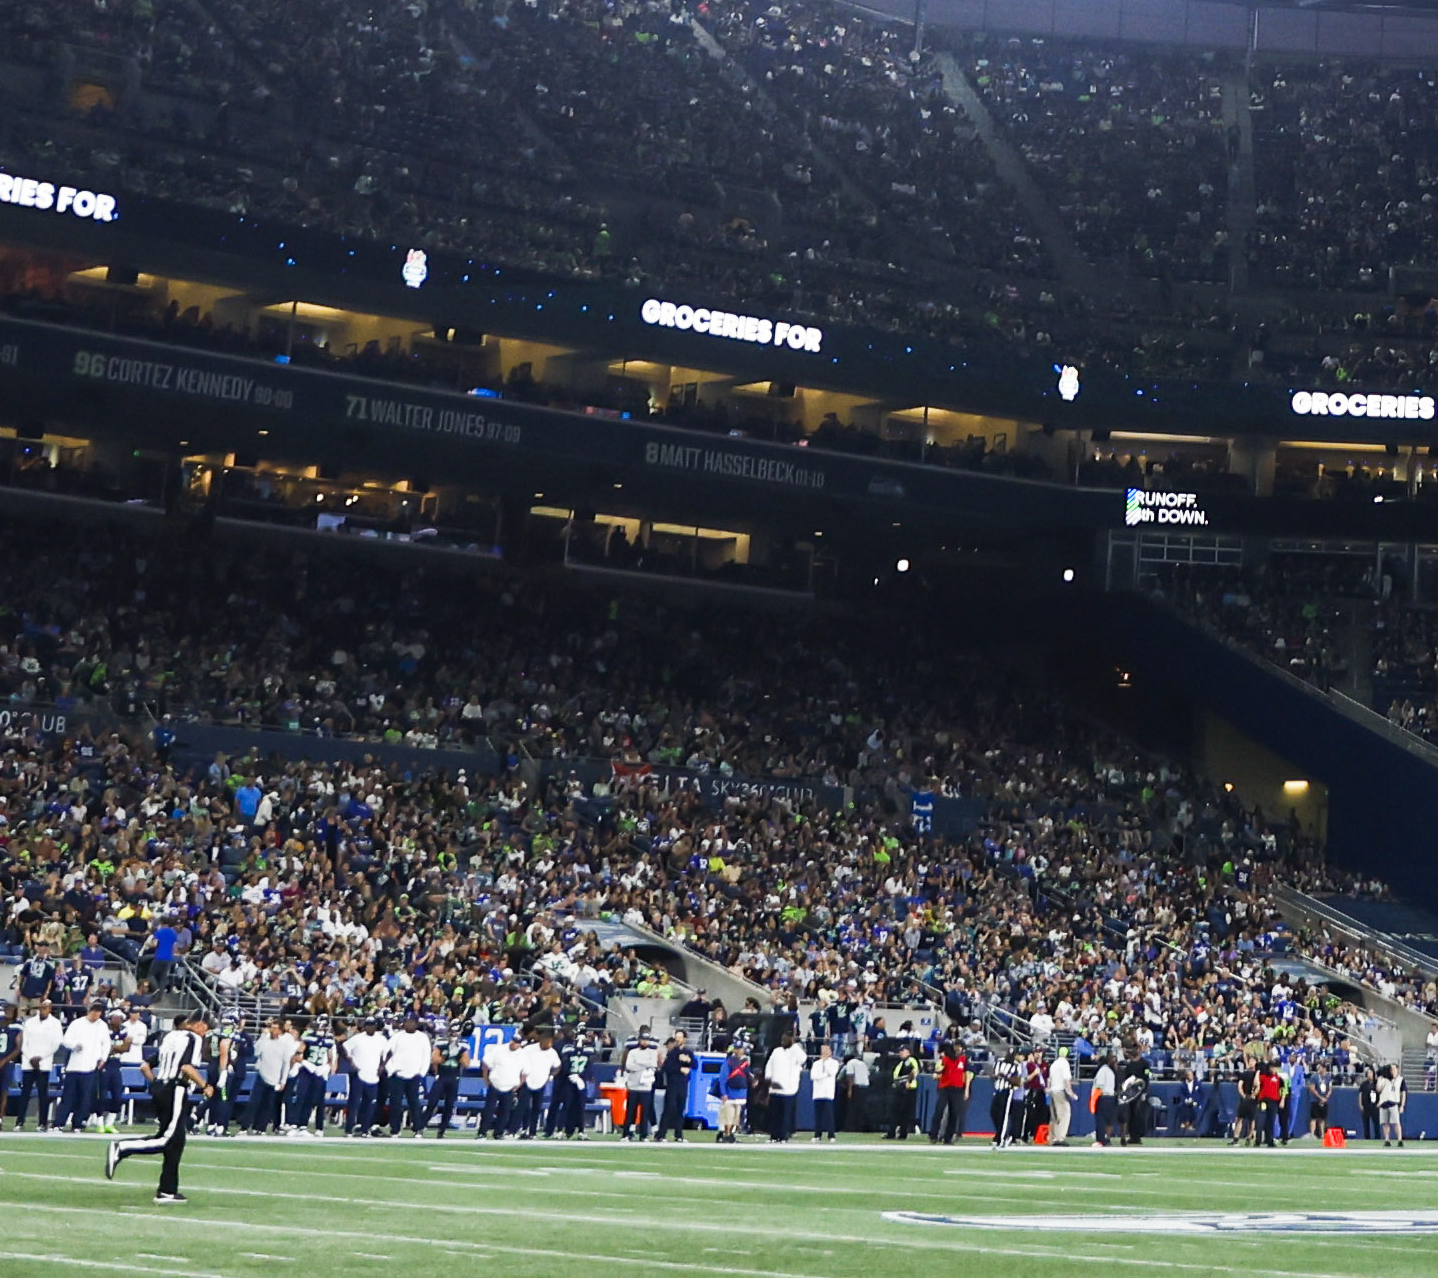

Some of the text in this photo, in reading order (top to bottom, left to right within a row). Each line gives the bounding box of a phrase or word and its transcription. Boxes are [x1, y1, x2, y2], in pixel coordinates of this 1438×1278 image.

[56, 187, 115, 222] FOR
[641, 299, 822, 353] GROCERIES FOR
[73, 350, 105, 379] 96
[107, 356, 172, 389] CORTEZ
[177, 367, 256, 403] KENNEDY
[345, 395, 370, 420] 71
[371, 399, 432, 430] WALTER
[436, 407, 485, 438] JONES
[1291, 392, 1435, 420] GROCERIES
[646, 442, 659, 465] 8
[660, 444, 702, 470] MATT
[704, 449, 796, 485] HASSELBECK
[1158, 508, 1209, 525] DOWN.
[72, 976, 89, 992] 37
